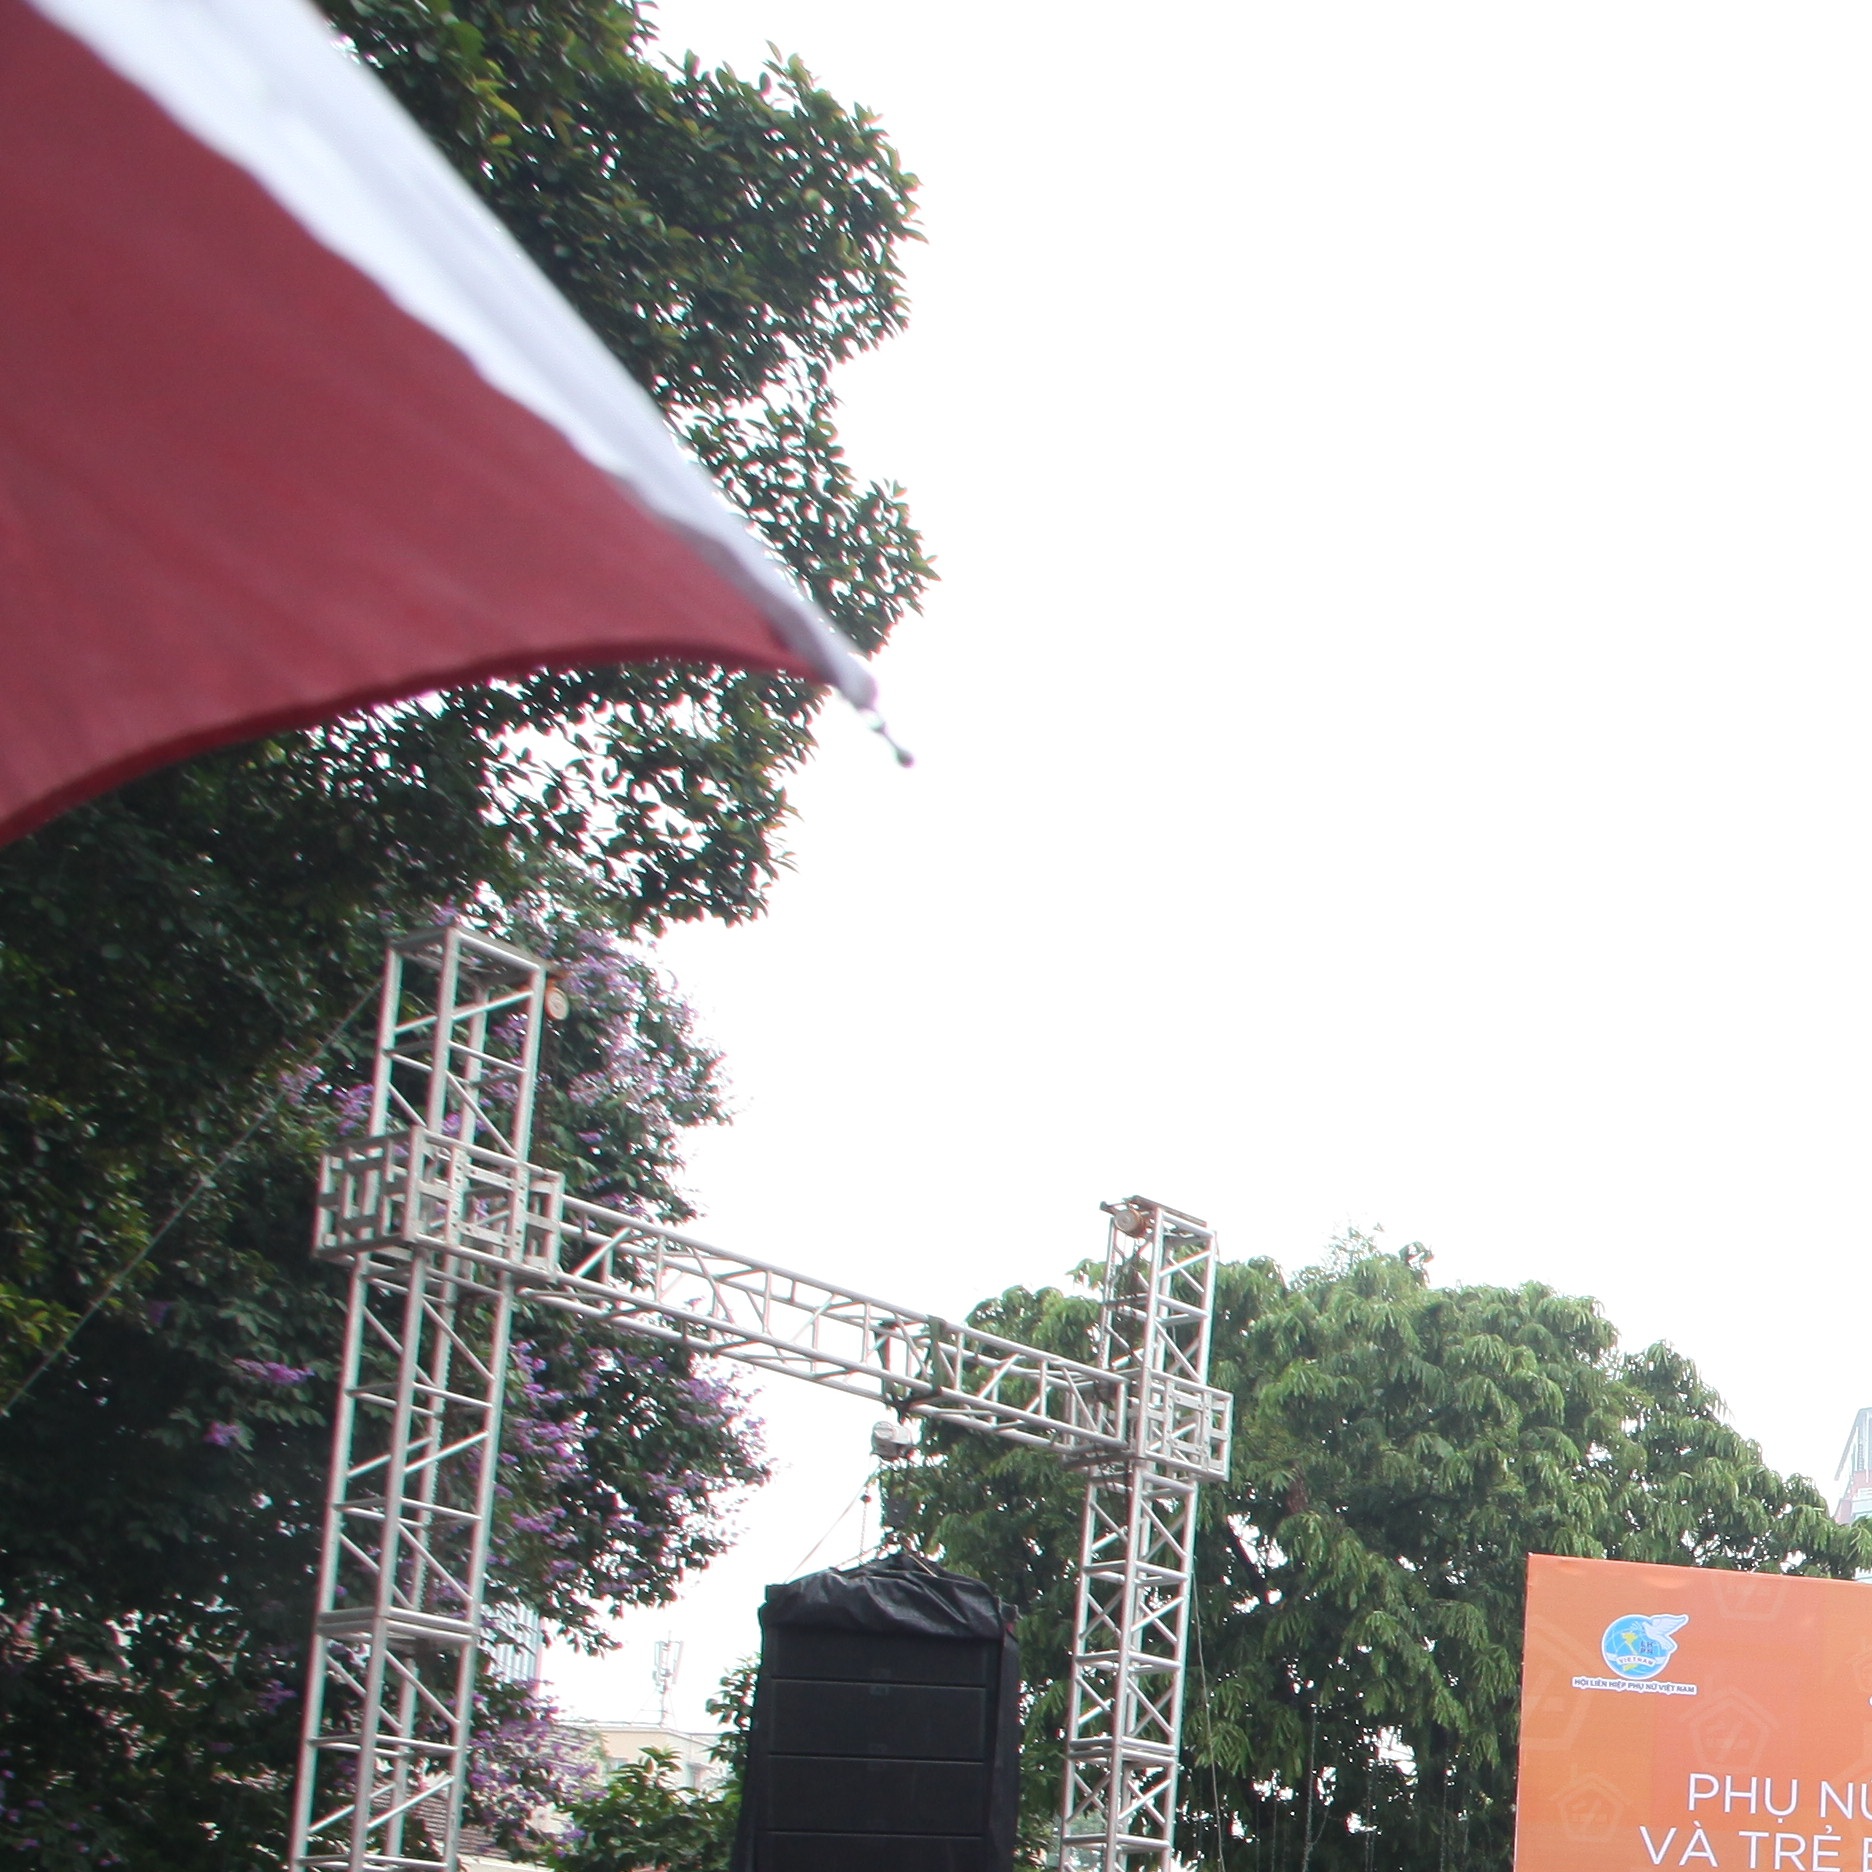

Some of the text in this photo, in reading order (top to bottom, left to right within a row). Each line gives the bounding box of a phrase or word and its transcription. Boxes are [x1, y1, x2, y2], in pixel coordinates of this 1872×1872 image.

[1689, 1774, 1797, 1827] PHỤ
[1640, 1821, 1717, 1867] VÀ
[1739, 1818, 1841, 1872] TRẺ
